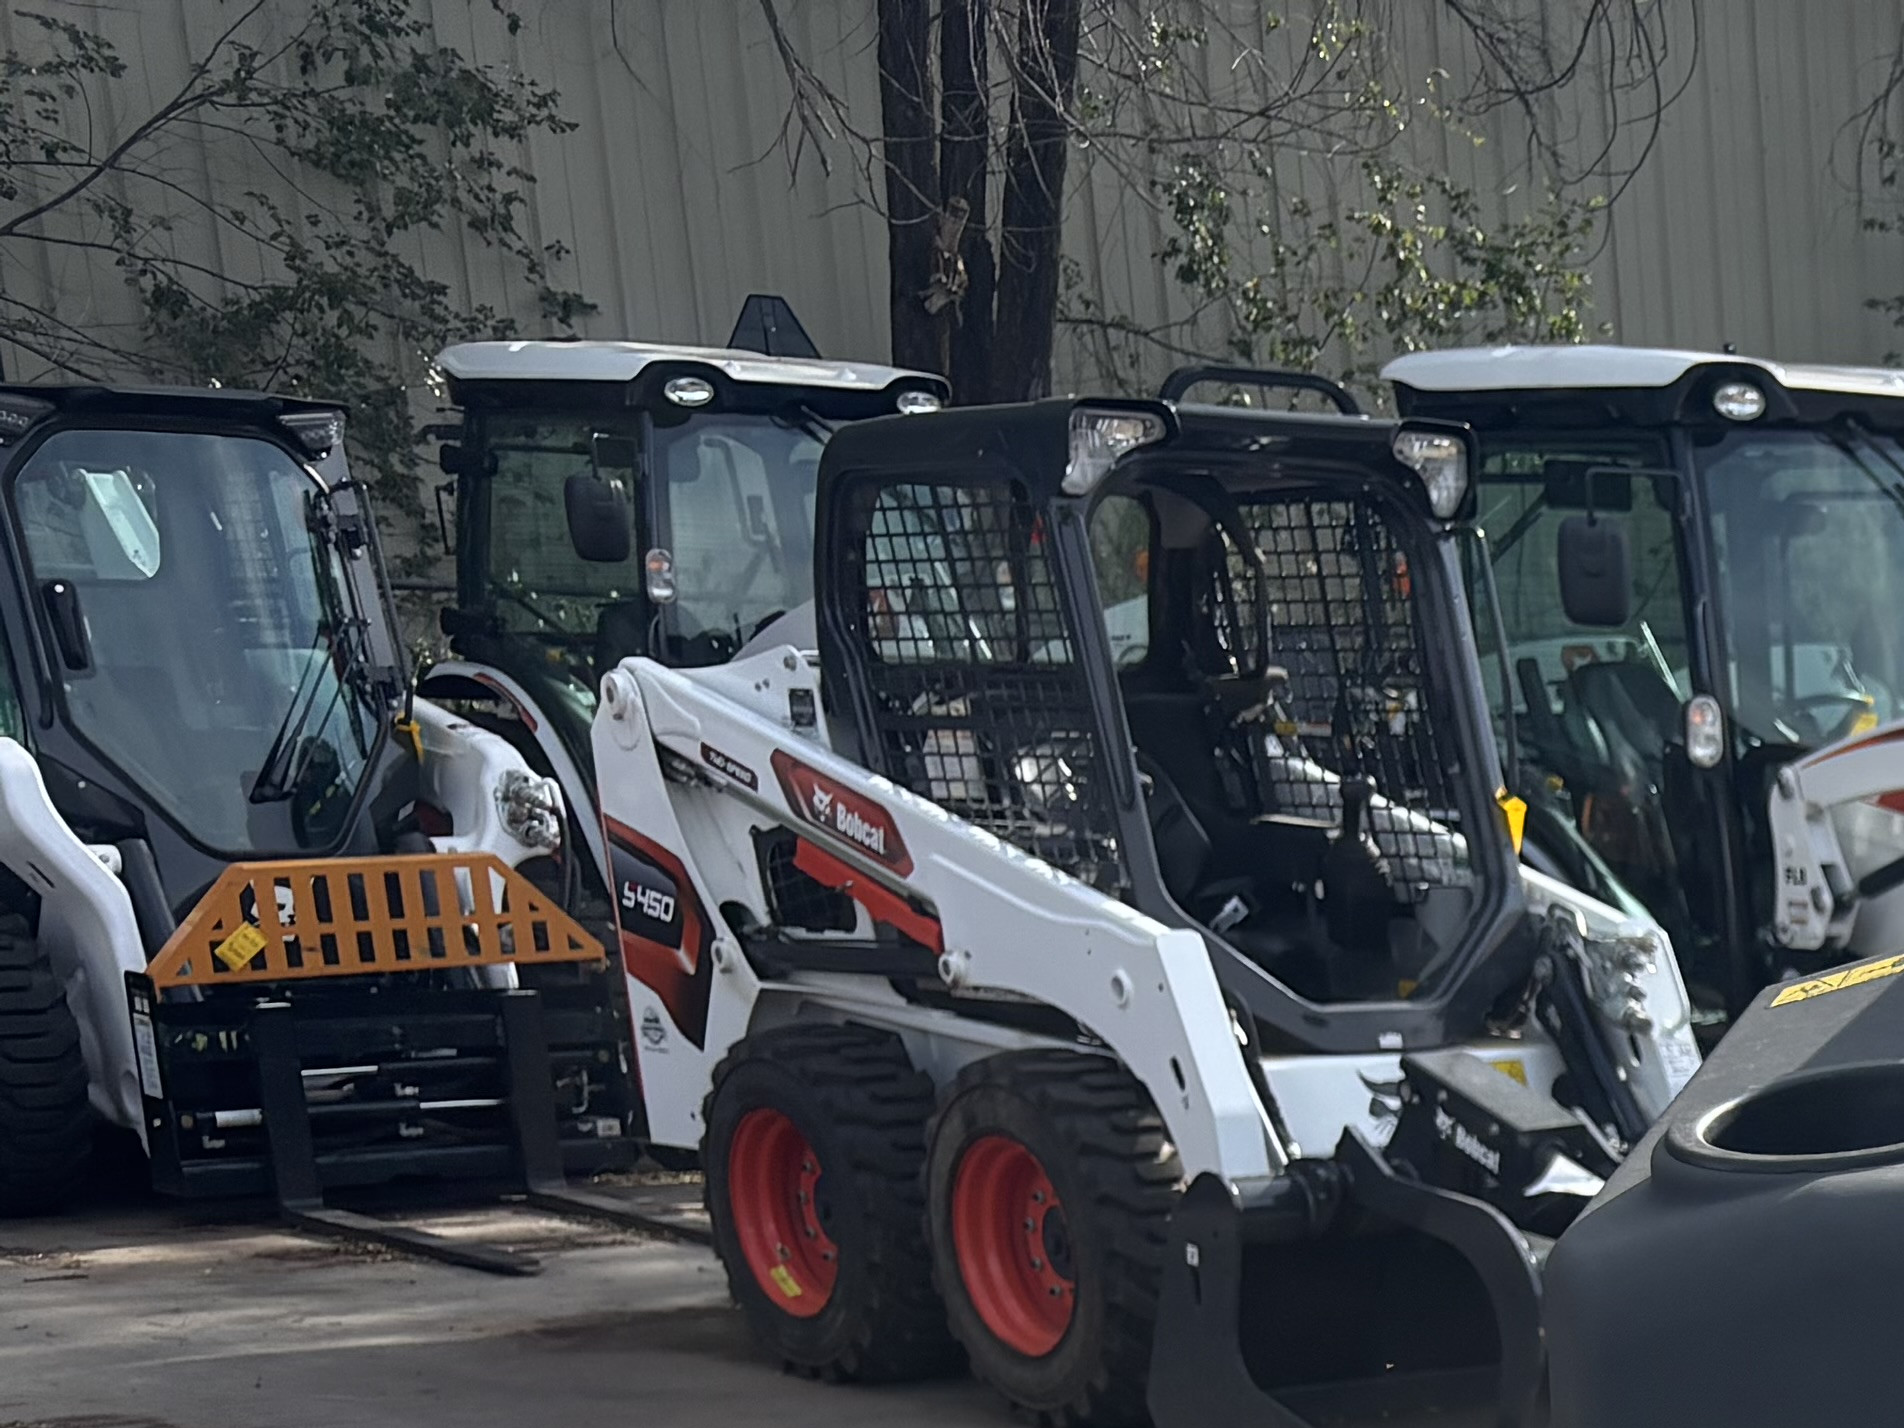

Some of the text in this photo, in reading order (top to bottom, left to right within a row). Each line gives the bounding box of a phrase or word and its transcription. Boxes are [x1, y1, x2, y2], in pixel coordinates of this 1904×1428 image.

[836, 801, 884, 855] Bobcat
[621, 881, 675, 923] S450
[1455, 1122, 1500, 1175] Bobcat
